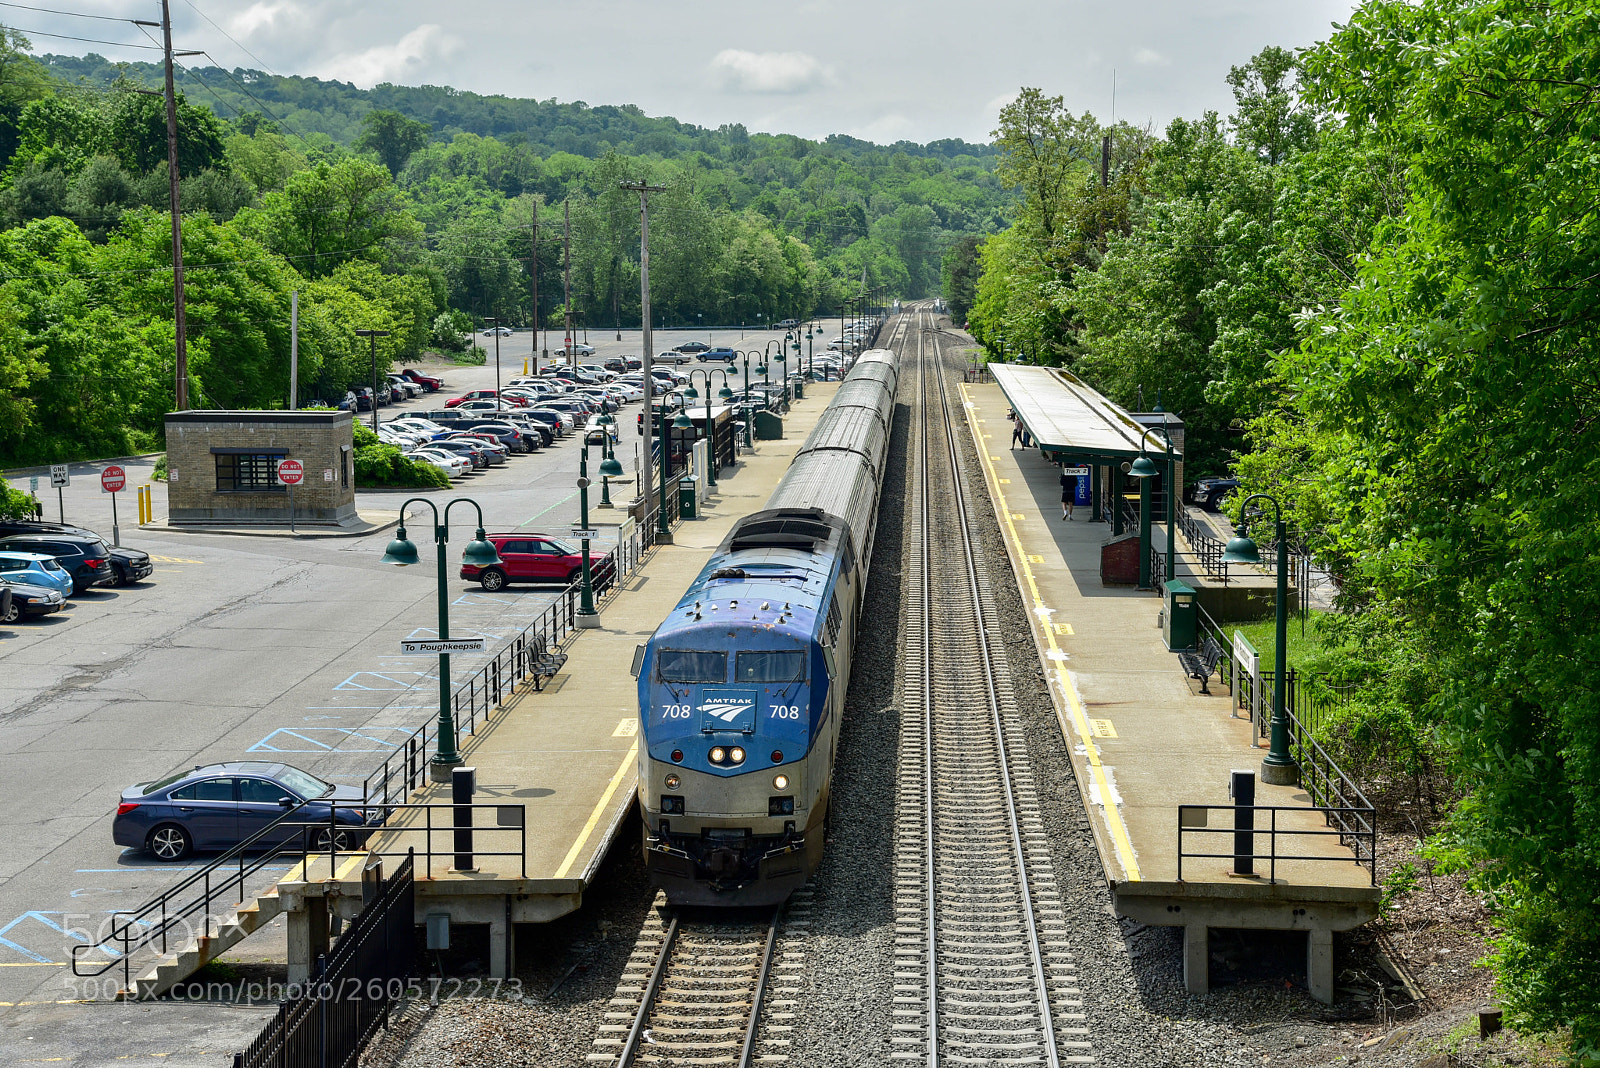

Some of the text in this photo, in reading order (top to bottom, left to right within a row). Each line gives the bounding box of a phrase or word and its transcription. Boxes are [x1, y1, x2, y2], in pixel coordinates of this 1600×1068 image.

[1078, 476, 1086, 499] pepsi
[420, 642, 482, 652] Poughkeepsie
[662, 704, 691, 719] 708
[769, 704, 799, 719] 708
